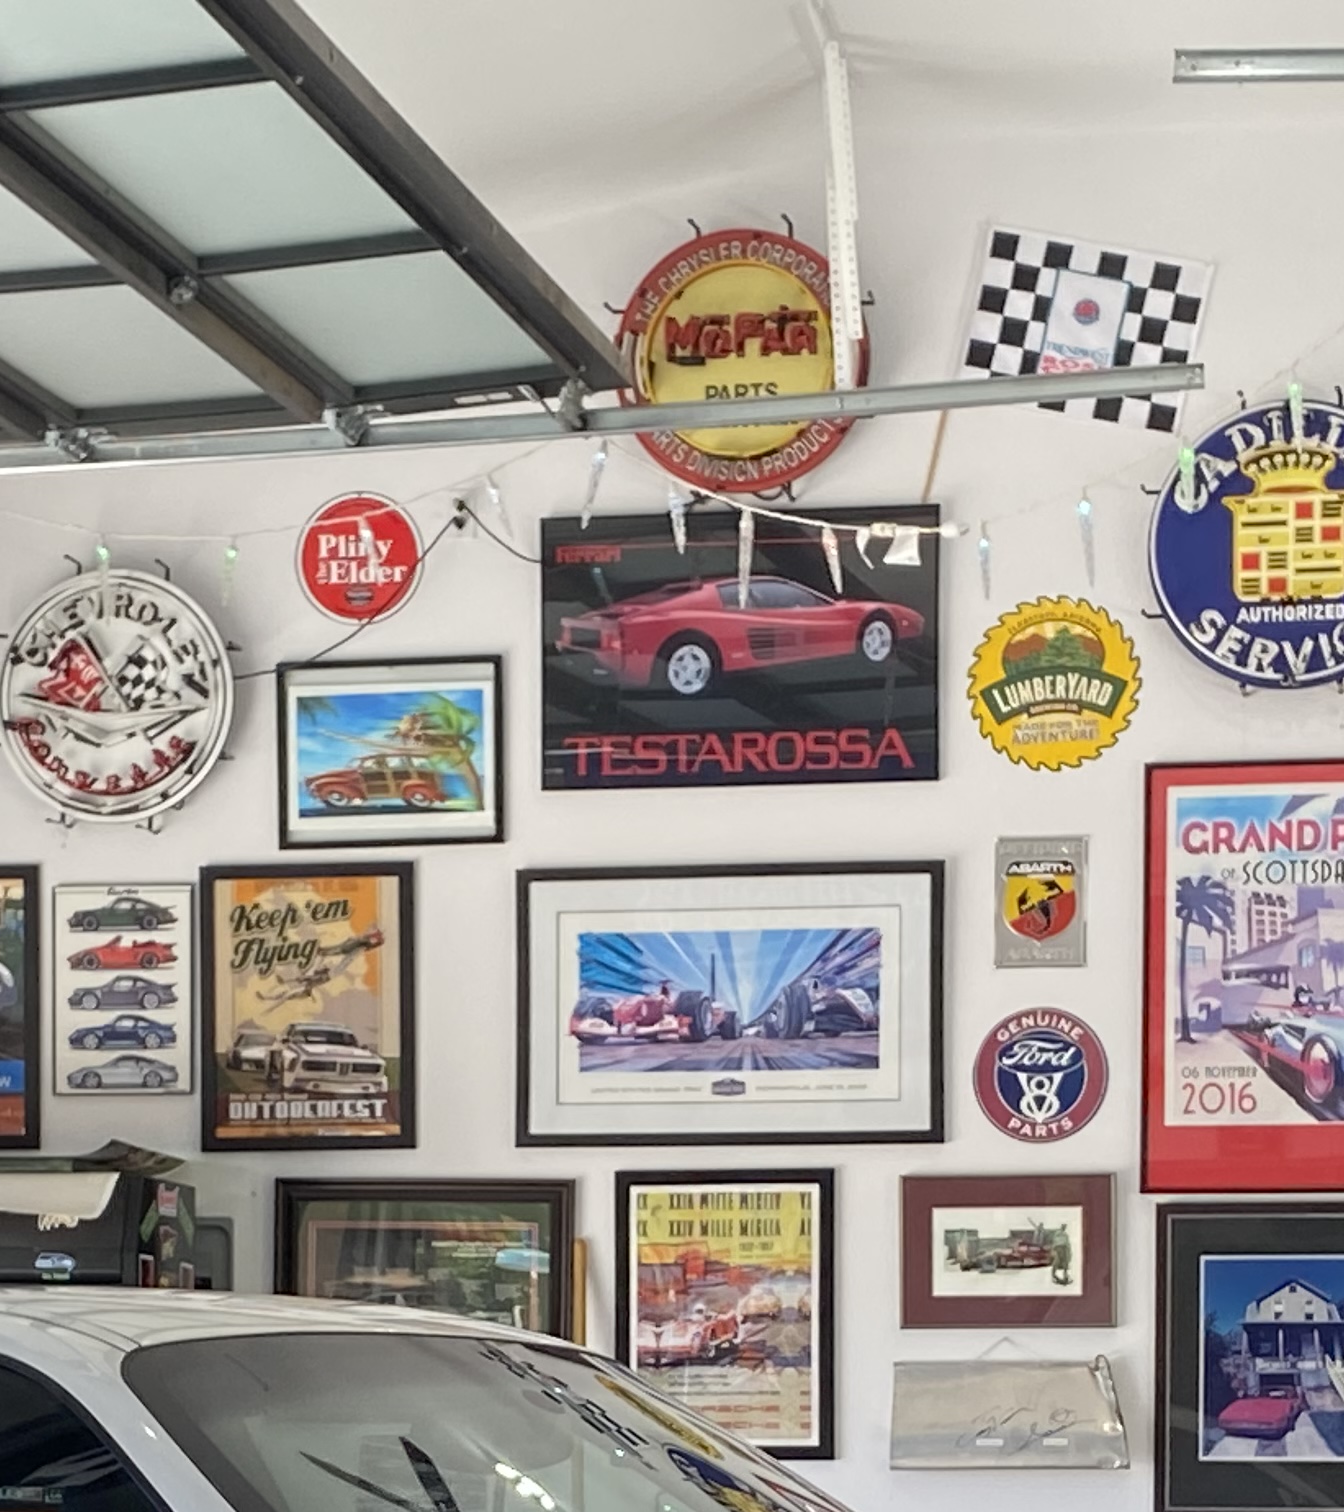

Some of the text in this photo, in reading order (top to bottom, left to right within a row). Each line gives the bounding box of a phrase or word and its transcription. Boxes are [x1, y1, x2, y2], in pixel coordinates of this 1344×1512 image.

[657, 241, 743, 295] CHRYSLER
[317, 533, 394, 562] Pliny
[329, 559, 408, 584] Elder
[1011, 729, 1096, 745] ADVENTURE
[1012, 721, 1047, 732] MADE
[563, 727, 916, 777] TESTAROSSA
[1181, 818, 1322, 855] GRAND
[1009, 863, 1072, 873] ABARTH
[230, 903, 300, 934] Keep
[231, 937, 318, 975] Flying
[996, 1010, 1084, 1041] GENUINE
[1001, 1040, 1076, 1067] Ford
[1181, 1066, 1258, 1079] 06 NOVEMBER
[229, 1100, 387, 1119] OKTOBERFEST
[1182, 1082, 1257, 1115] 2016
[1008, 1116, 1074, 1137] PARTS
[699, 1219, 733, 1237] MILLE
[739, 1218, 781, 1236] MIGLIA
